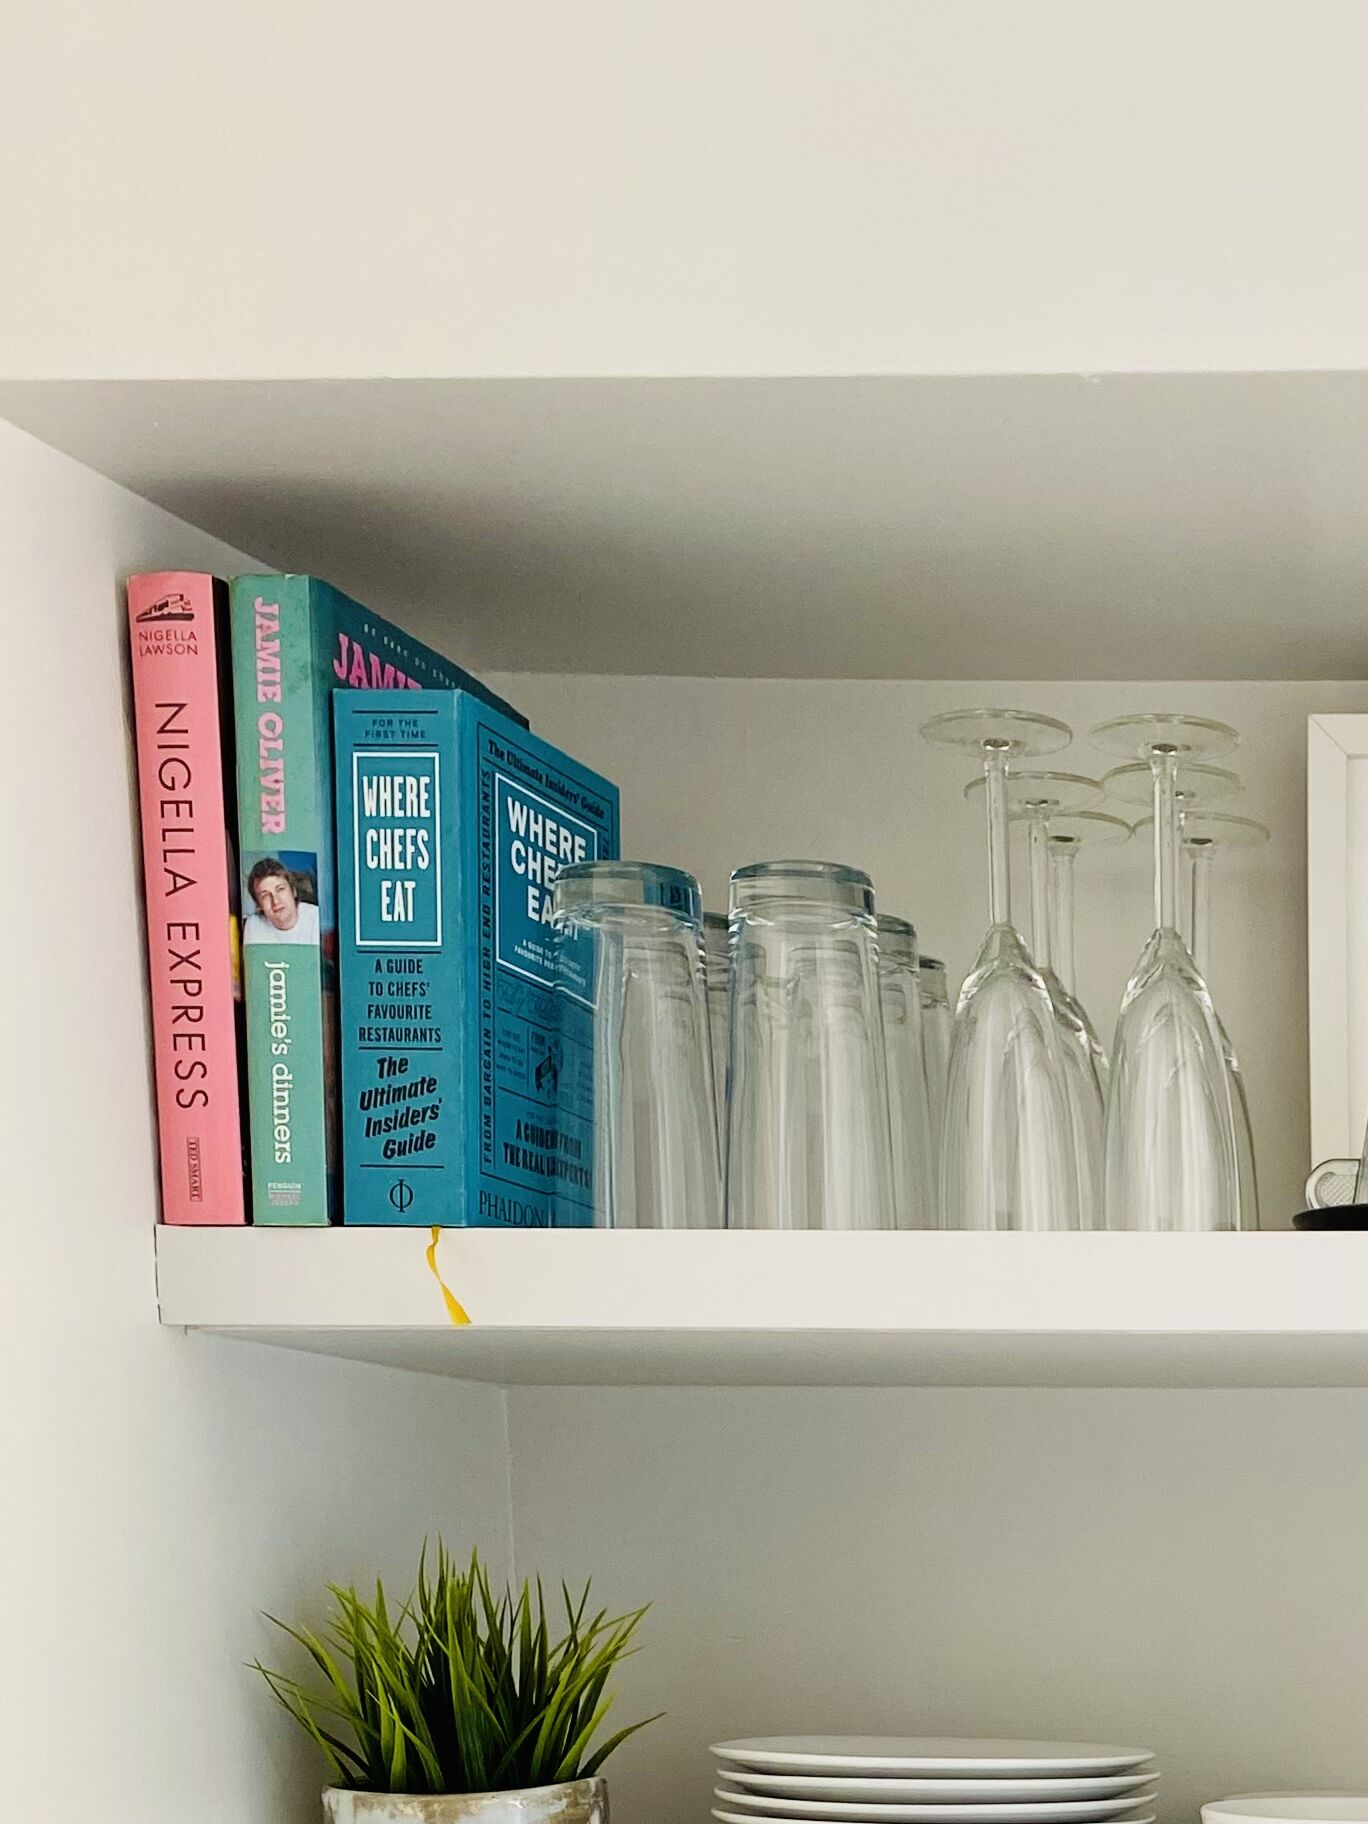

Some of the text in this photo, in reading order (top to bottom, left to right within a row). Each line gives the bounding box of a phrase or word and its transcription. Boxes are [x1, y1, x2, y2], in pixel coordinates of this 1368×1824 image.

[139, 630, 197, 643] NIGELLA
[139, 643, 198, 658] LAWSON
[255, 597, 286, 835] JAMIE OLIVER
[371, 719, 419, 728] FOR THE
[364, 730, 426, 739] FIRST TIME
[488, 738, 505, 761] The
[507, 750, 543, 784] Ultimate
[581, 793, 605, 818] Guide
[362, 775, 431, 818] WHERE
[507, 796, 586, 863] WHERE
[366, 828, 430, 870] CHEFS
[154, 703, 209, 1109] NIGELLA EXPRESS
[381, 880, 416, 922] EAT
[374, 958, 424, 975] A GUIDE
[482, 769, 492, 1165] FROM BARGAIN TO HIGH END RESTAURANTS
[368, 981, 430, 998] TO CHEFS'
[264, 960, 292, 1056] jamie's
[367, 1003, 433, 1020] FAVOURITE
[358, 1026, 442, 1043] RESTAURANTS
[376, 1056, 409, 1080] The
[359, 1076, 438, 1111] Ultimate
[272, 1062, 294, 1165] dinners
[364, 1097, 443, 1138] Insiders'
[515, 1119, 522, 1141] A
[382, 1129, 437, 1160] Guide
[503, 1141, 521, 1168] THE
[521, 1148, 545, 1177] REAL
[479, 1190, 546, 1227] PHAIDON
